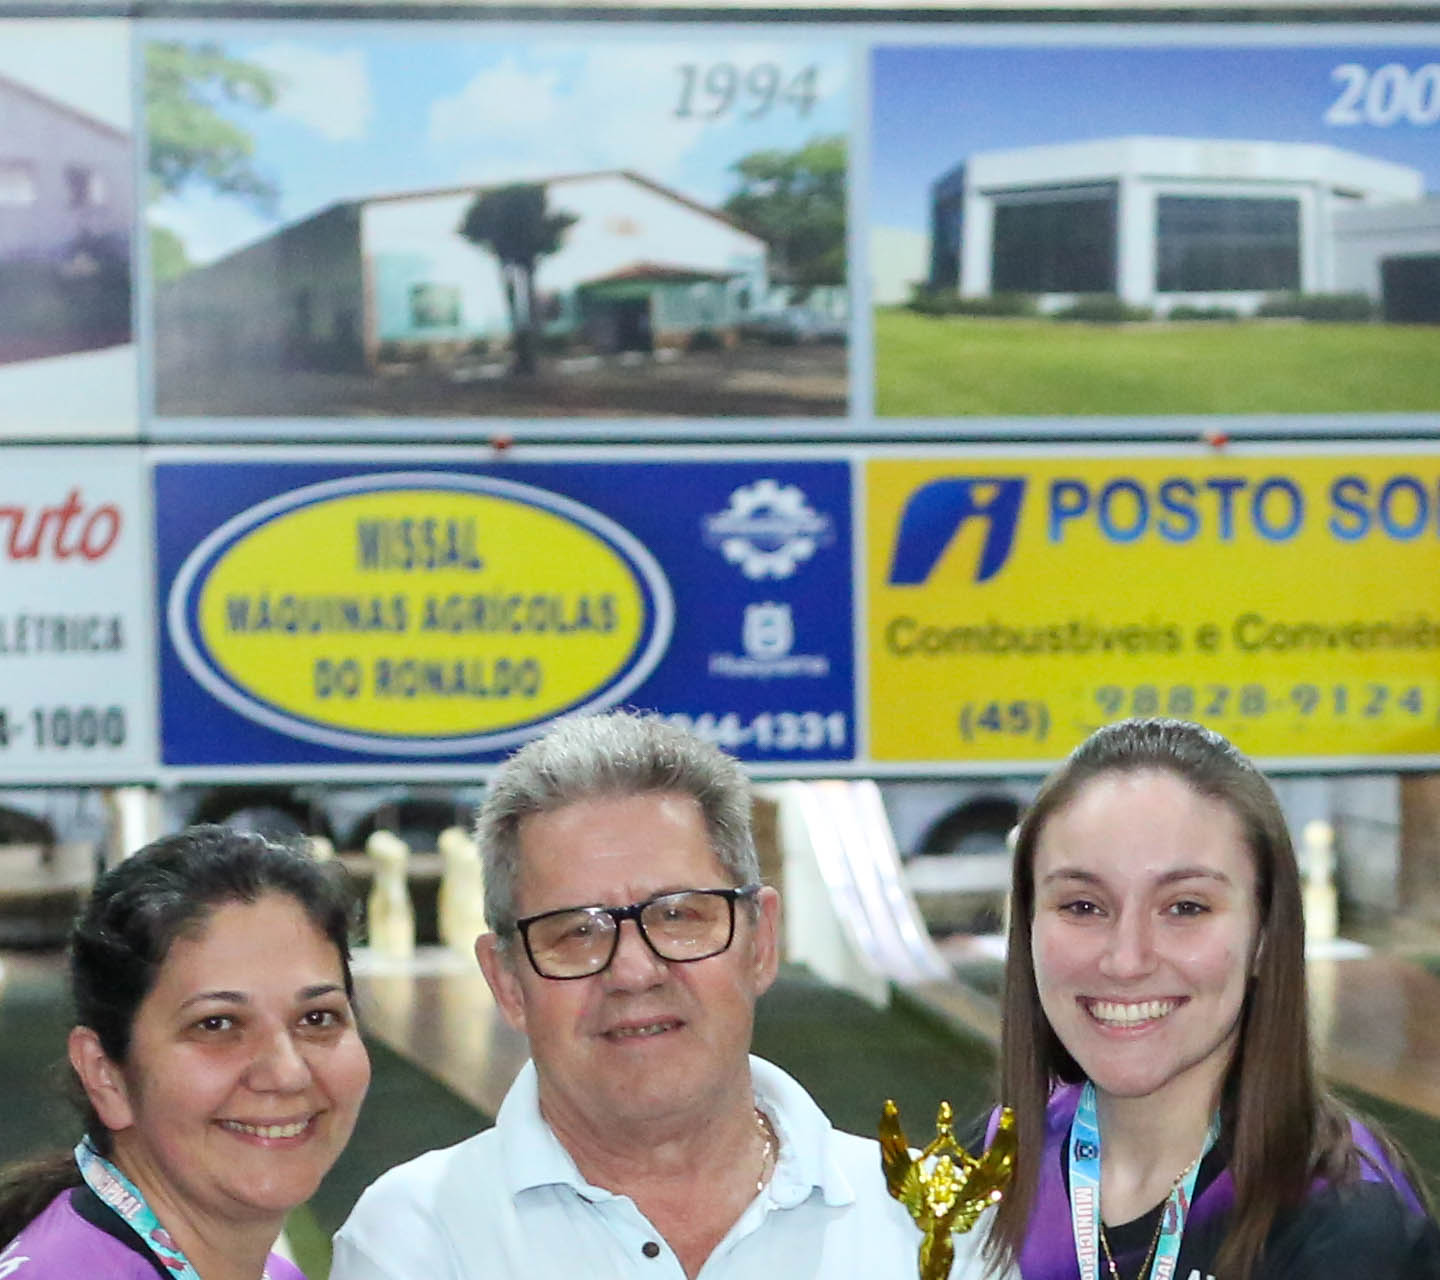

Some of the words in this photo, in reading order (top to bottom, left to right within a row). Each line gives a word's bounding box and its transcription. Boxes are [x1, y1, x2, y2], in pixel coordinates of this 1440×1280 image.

[671, 62, 822, 121] 1994
[1046, 475, 1305, 545] POSTO
[355, 517, 484, 571] MISSAL
[224, 588, 409, 635] MÁQUINAS
[421, 586, 620, 634] AGRÍCOLAS
[1196, 623, 1219, 653] e
[314, 658, 361, 700] DO
[373, 656, 542, 699] RONALDO
[959, 699, 1051, 742] (45)
